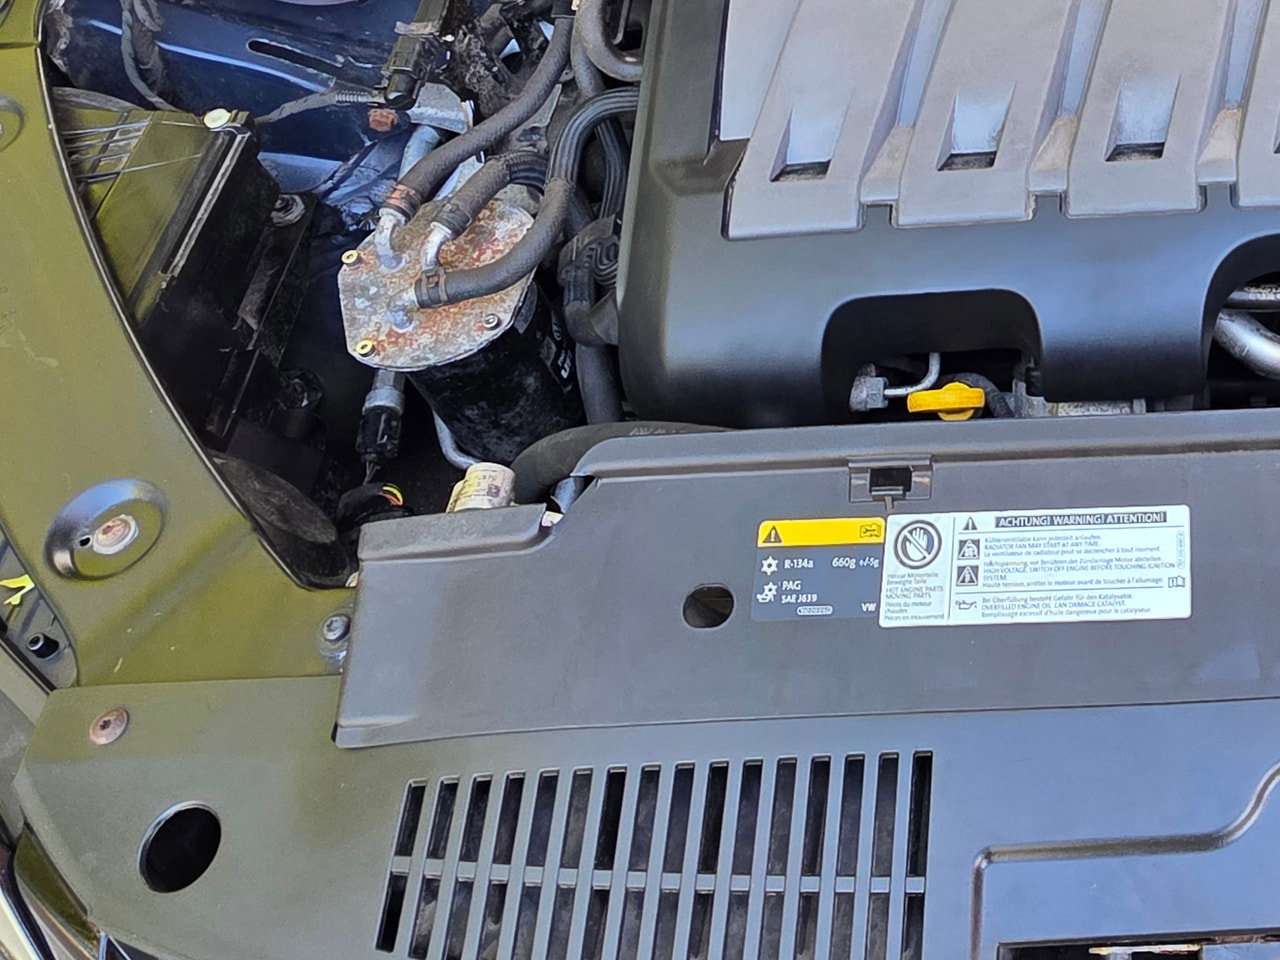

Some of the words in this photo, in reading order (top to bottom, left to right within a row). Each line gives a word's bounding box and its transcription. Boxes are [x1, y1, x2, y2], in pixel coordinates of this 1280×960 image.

[999, 516, 1050, 527] ACHTUNG!
[1053, 514, 1105, 525] WARNING!
[1106, 512, 1164, 523] ATTENTION!
[784, 558, 814, 569] R-134a
[831, 556, 857, 569] 660g
[782, 581, 801, 591] PAG
[861, 602, 878, 612] VW
